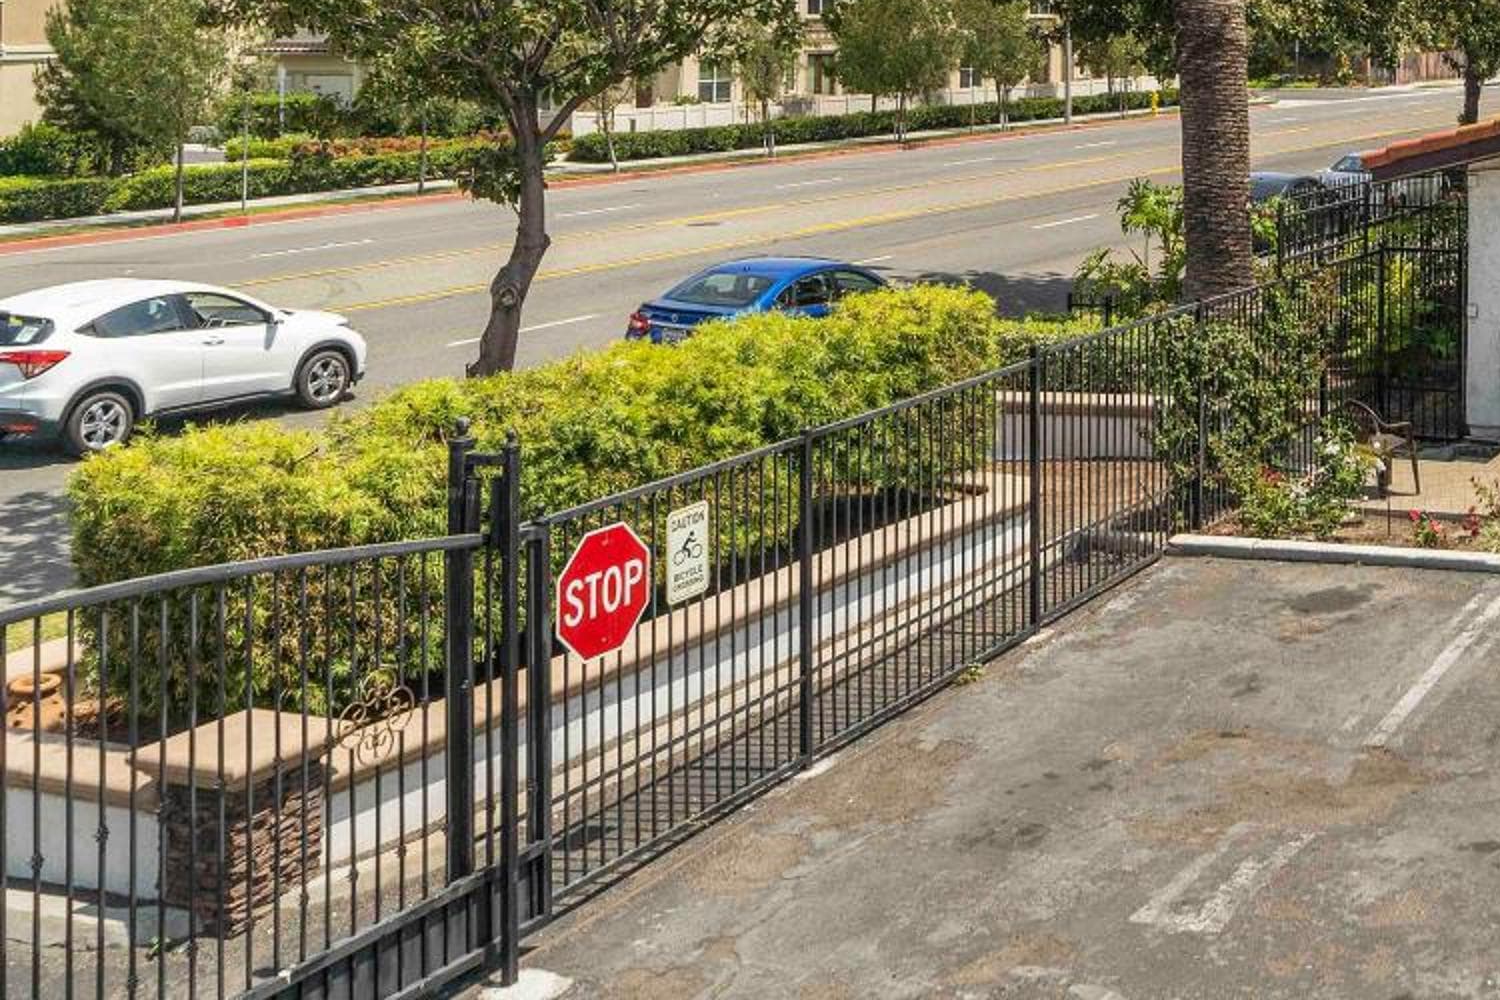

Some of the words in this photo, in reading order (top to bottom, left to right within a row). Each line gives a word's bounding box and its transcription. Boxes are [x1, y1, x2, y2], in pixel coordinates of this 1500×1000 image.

[671, 510, 705, 533] CAUTION
[673, 564, 703, 583] BICYCLE
[564, 558, 643, 627] STOP
